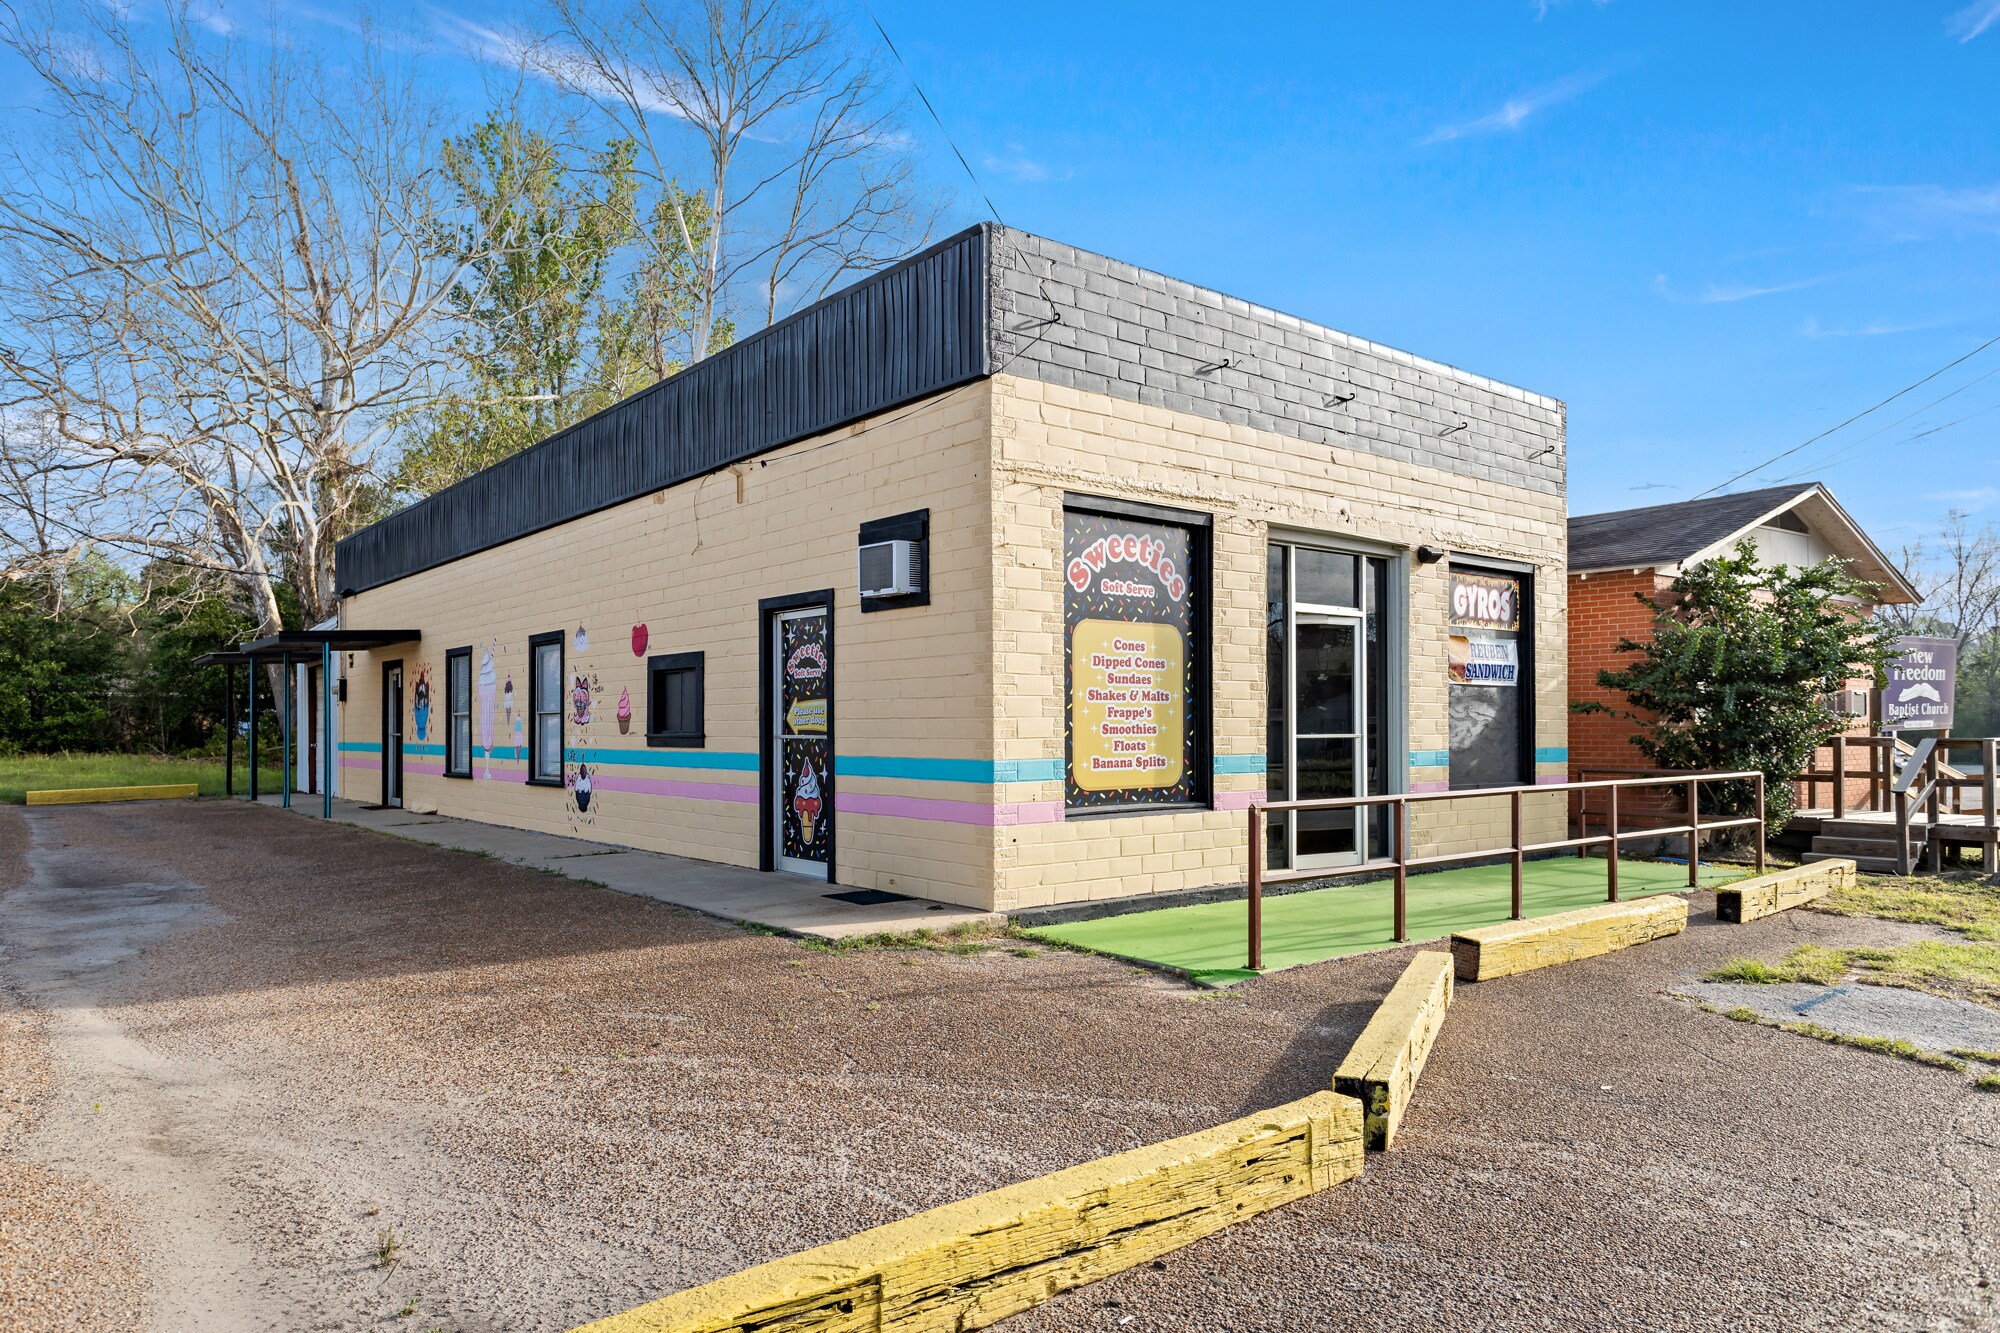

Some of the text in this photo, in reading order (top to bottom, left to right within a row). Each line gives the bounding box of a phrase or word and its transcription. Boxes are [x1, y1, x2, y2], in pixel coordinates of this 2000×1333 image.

[1068, 535, 1184, 600] Sweeties
[1102, 580, 1154, 596] Soft Serve
[1454, 584, 1510, 621] GYROS
[1113, 639, 1146, 652] Cones
[1469, 643, 1509, 660] REUBEN
[787, 643, 827, 674] Sweeties
[1092, 655, 1166, 669] Dipped Cones
[1908, 648, 1934, 664] New
[806, 668, 821, 677] Serve
[1465, 662, 1515, 680] SANDWICH
[1107, 672, 1152, 685] Sundaes
[1087, 689, 1170, 702] Shakes & Malts
[794, 707, 824, 716] Please use
[1107, 706, 1152, 720] Frappe's
[1888, 702, 1949, 717] Baptist Church
[793, 716, 825, 726] other door
[1101, 723, 1157, 735] Smoothies
[1113, 740, 1146, 752] Floats
[1092, 756, 1166, 770] Banana Splits
